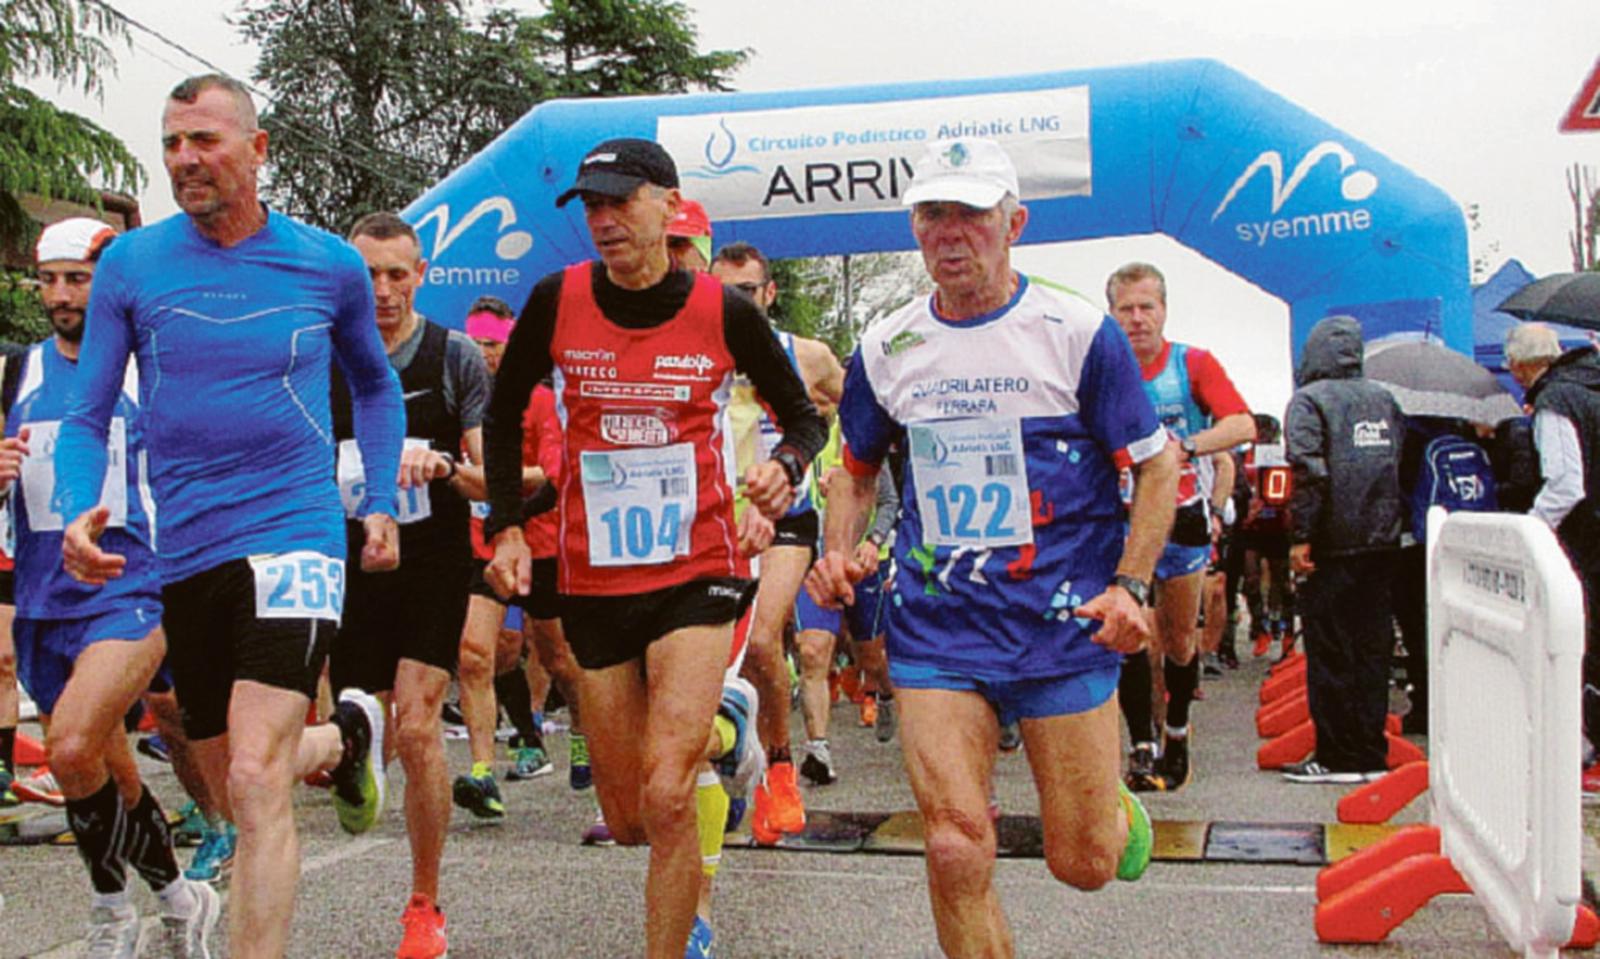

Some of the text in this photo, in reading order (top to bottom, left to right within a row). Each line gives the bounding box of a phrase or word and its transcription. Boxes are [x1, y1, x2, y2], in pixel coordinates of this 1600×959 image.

[748, 114, 1061, 152] Circuito Podistico Adriatic LNG
[1235, 208, 1371, 247] syemme
[428, 265, 521, 286] emme
[1268, 469, 1287, 499] 0
[926, 482, 1014, 538] 122
[601, 504, 681, 557] 104
[266, 559, 343, 614] 253
